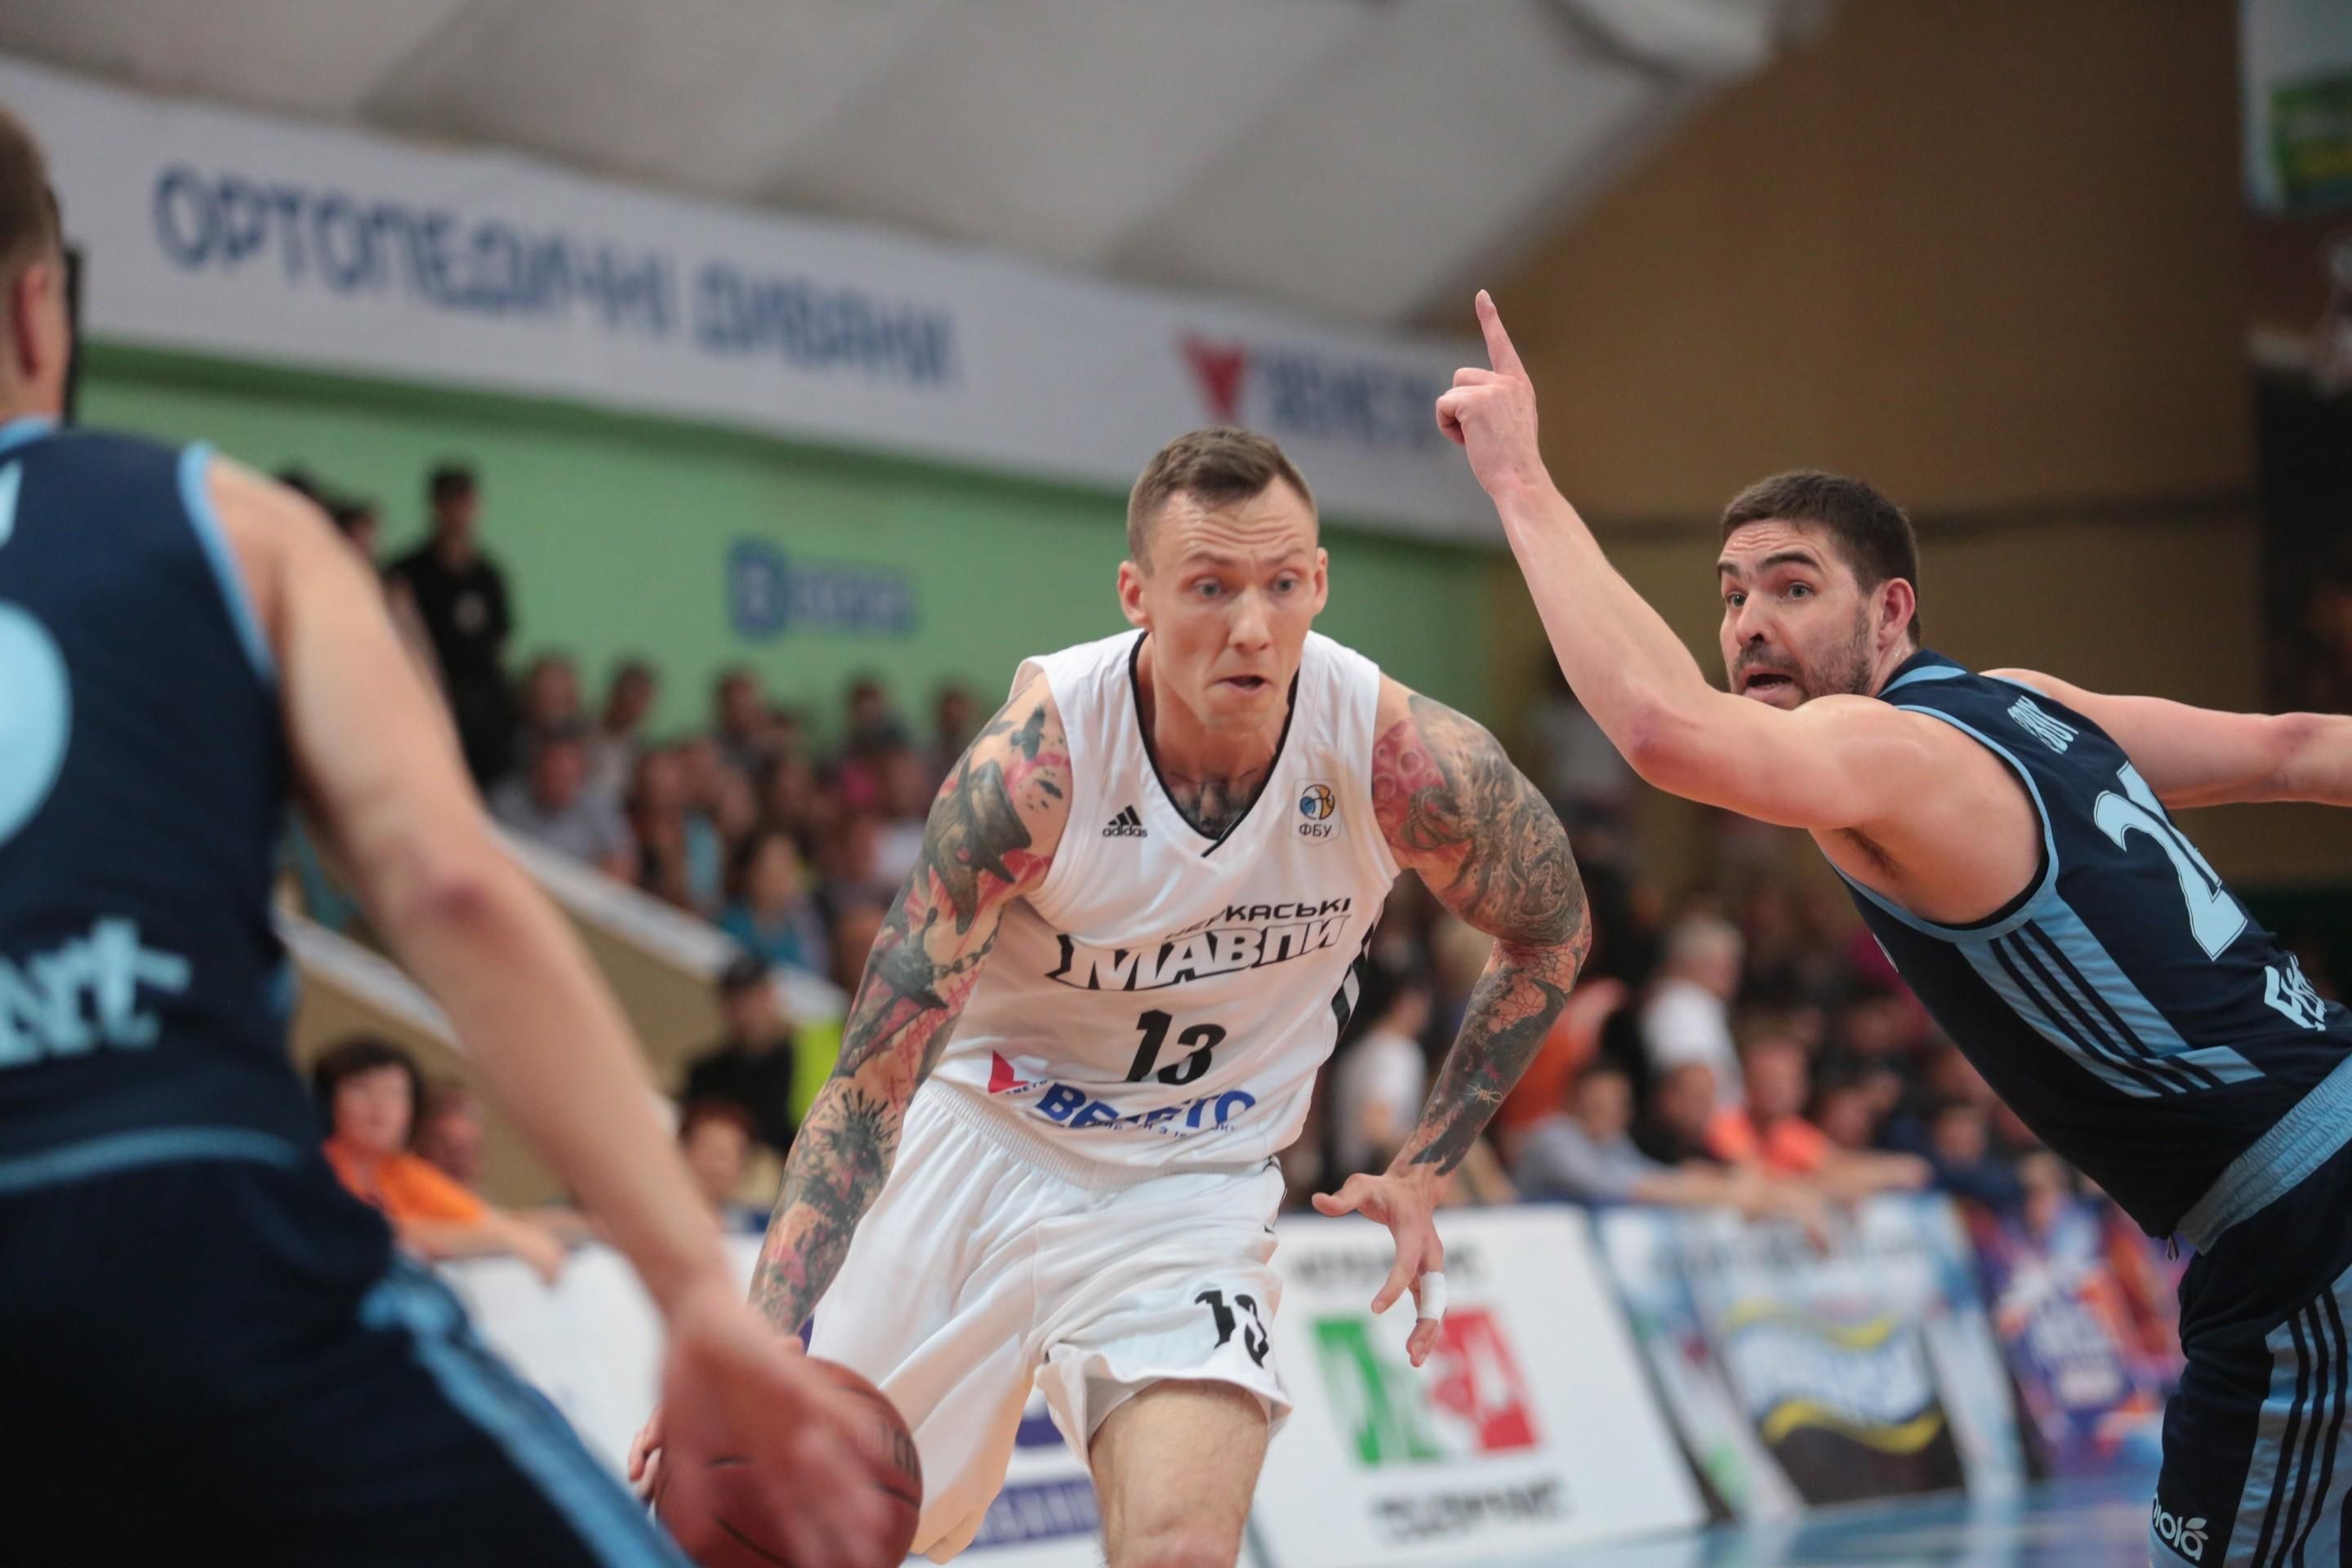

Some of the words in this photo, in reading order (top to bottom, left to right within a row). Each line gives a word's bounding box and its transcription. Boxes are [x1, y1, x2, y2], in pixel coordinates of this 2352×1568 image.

[1102, 824, 1147, 838] adidas
[1299, 823, 1332, 838] ФБУ
[1166, 898, 1352, 938] КАСЬКІ
[1045, 915, 1352, 991] МАВПИ
[1125, 1009, 1227, 1086] 13
[1036, 1082, 1256, 1129] ВЕТО
